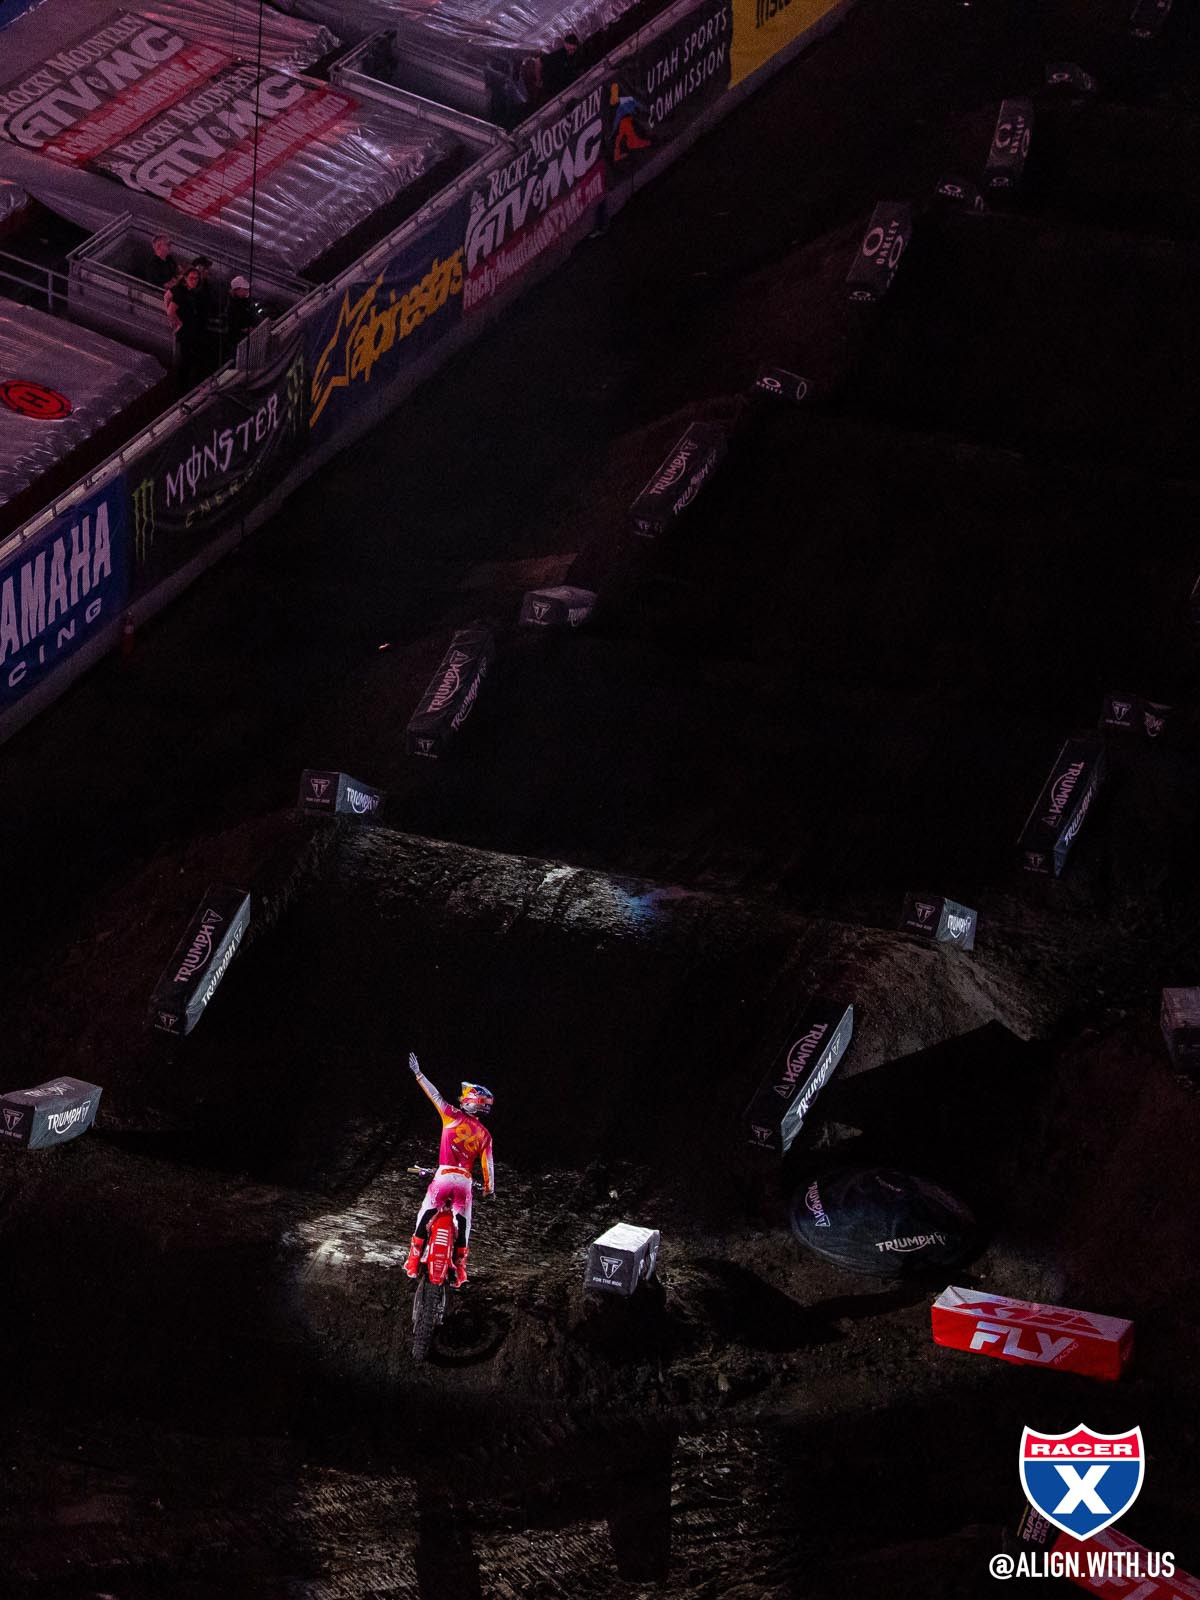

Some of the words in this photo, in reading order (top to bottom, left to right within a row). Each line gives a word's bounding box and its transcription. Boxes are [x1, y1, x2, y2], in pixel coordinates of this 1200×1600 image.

[46, 11, 148, 73] MOUNTAIN
[647, 48, 679, 94] UTAH
[684, 7, 727, 63] SPORTS
[648, 42, 726, 129] COMMISSION
[112, 118, 185, 163] ROCKY
[487, 149, 533, 207] ROCKY
[166, 392, 279, 508] MONSTER
[649, 449, 692, 497] TRIUMPH
[425, 663, 462, 713] TRIUMPH
[1050, 761, 1085, 815] TRIUMPH
[173, 923, 217, 984] TRIUMPH
[782, 1013, 830, 1084] TRIUMPH
[47, 1106, 81, 1134] TRIUMPH
[804, 1180, 825, 1219] TRIUMPH
[874, 1234, 937, 1253] TRIUMPH
[969, 1320, 1076, 1364] FLY
[1053, 1341, 1080, 1365] RACING
